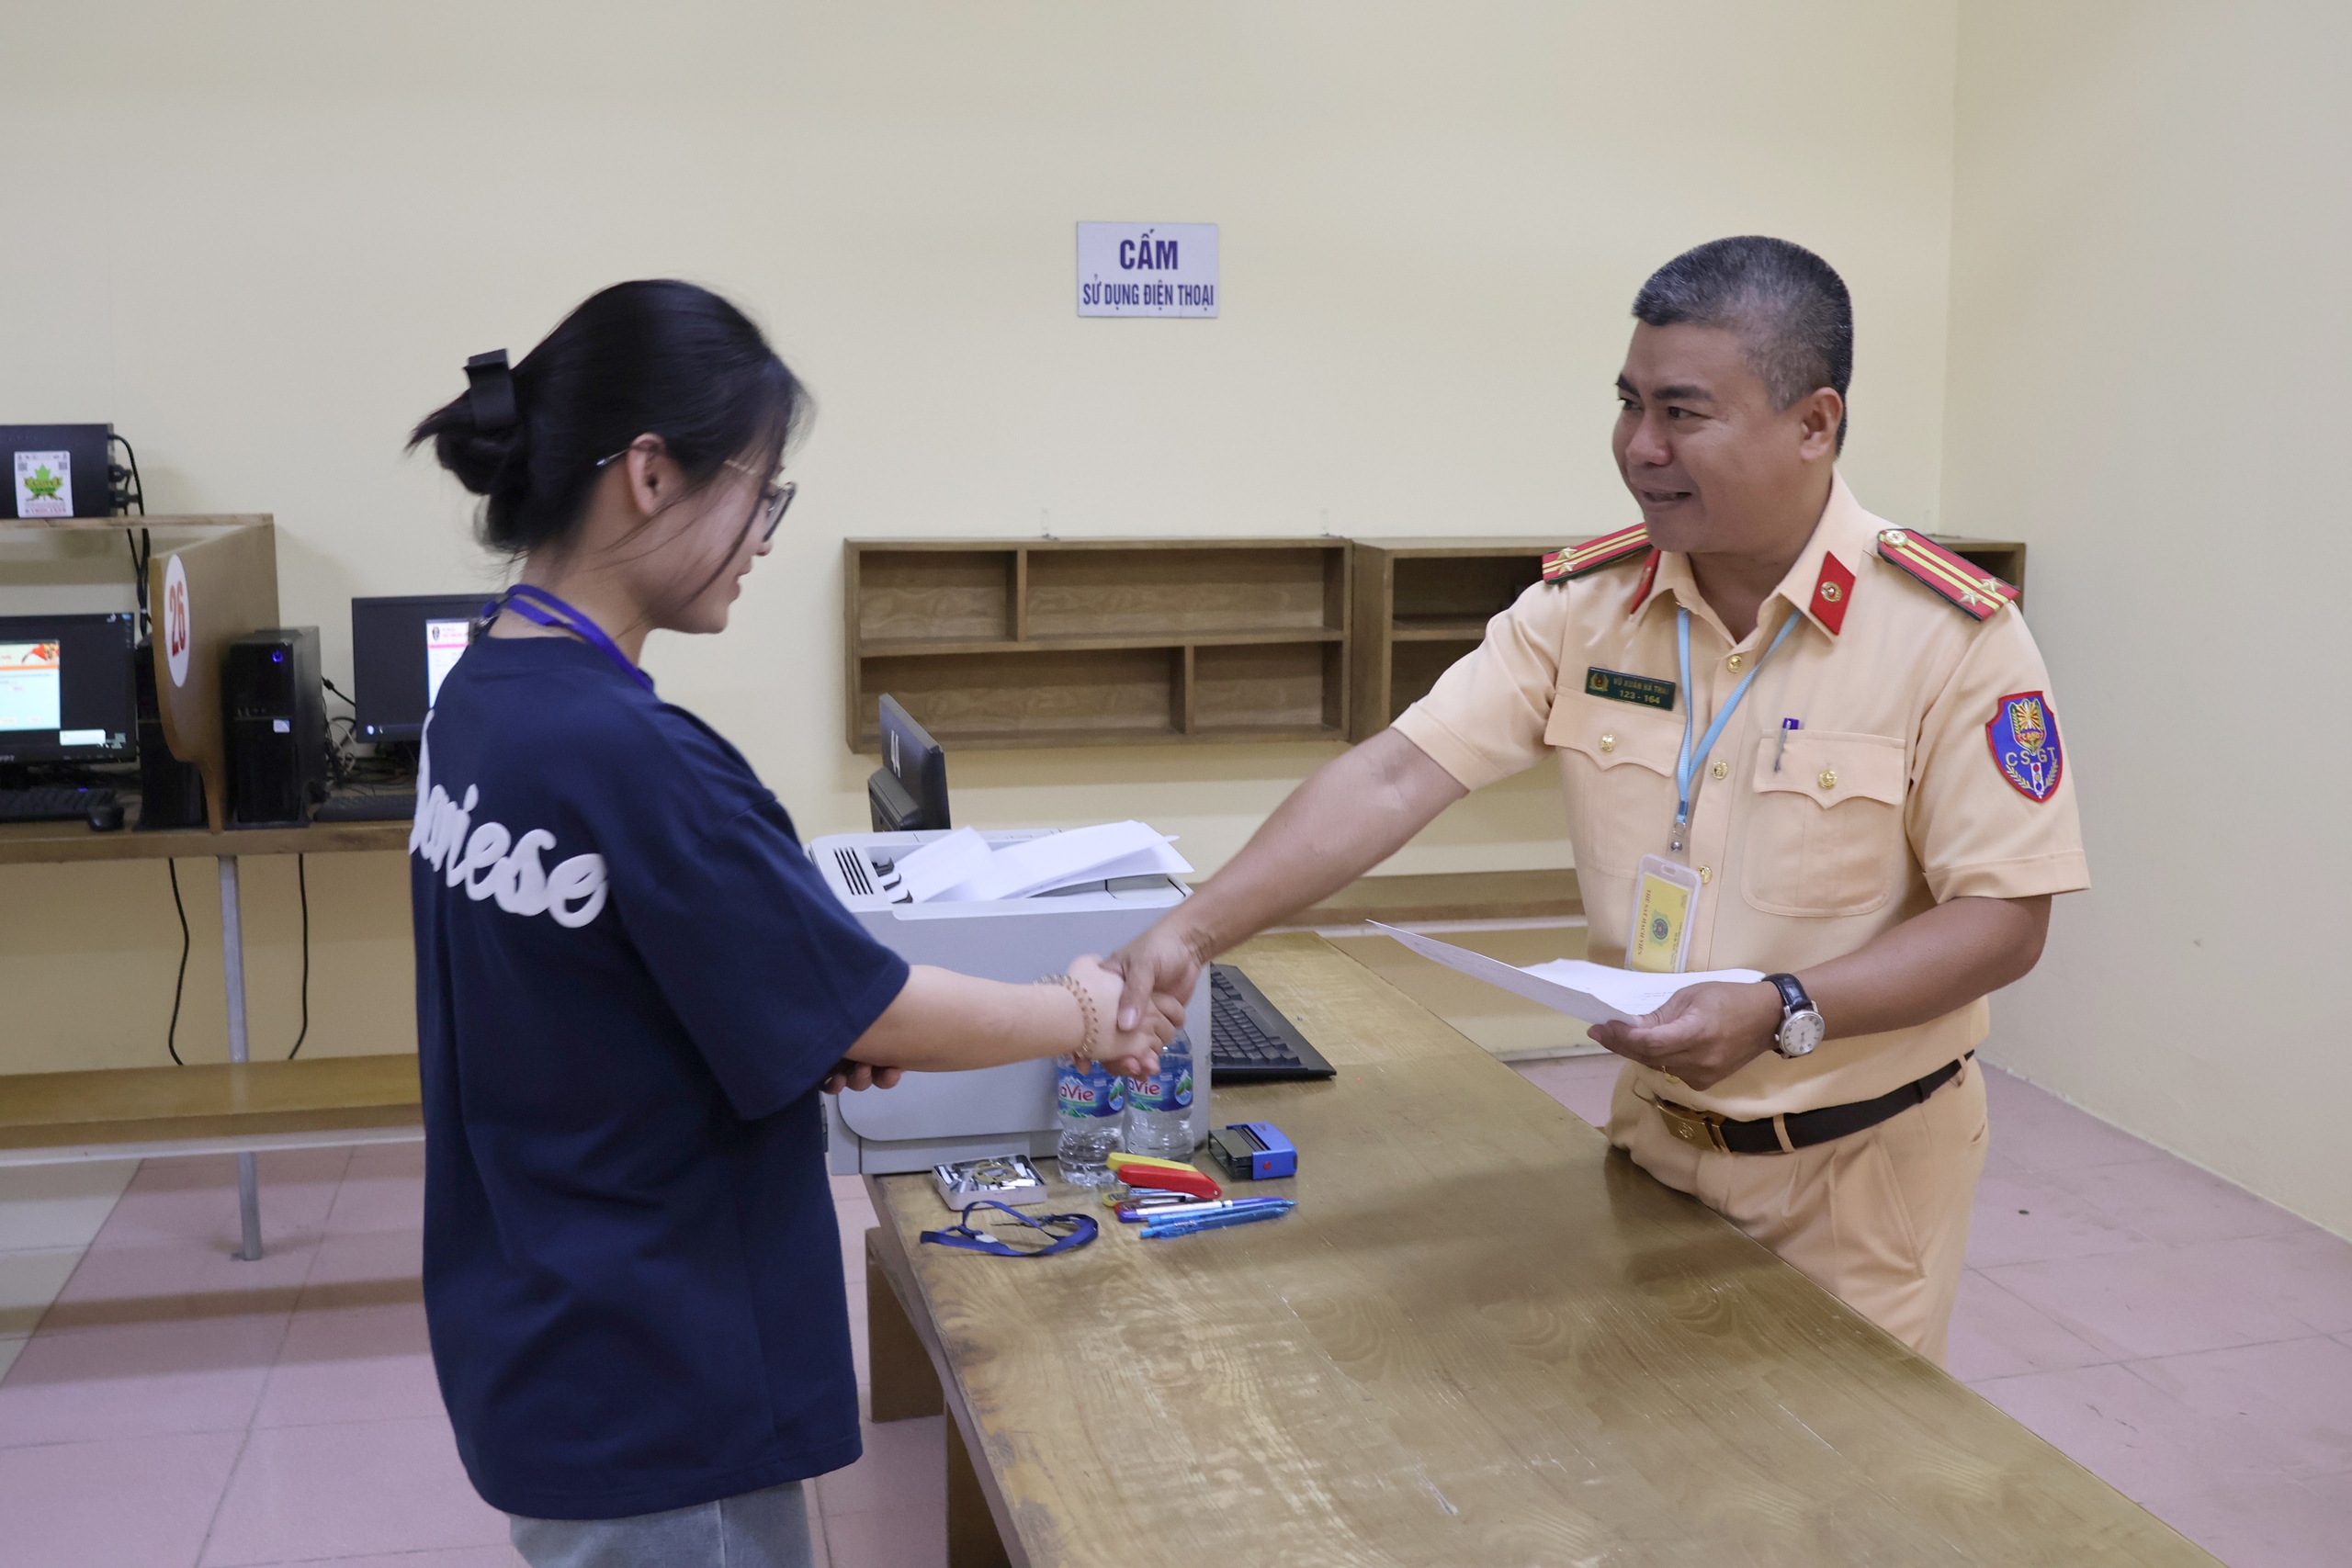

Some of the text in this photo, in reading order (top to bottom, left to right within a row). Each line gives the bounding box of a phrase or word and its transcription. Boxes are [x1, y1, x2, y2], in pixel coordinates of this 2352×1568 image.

[1120, 229, 1179, 270] CẤM
[1082, 274, 1215, 311] SỬ DỤNG ĐIỆN THOẠI
[169, 581, 186, 658] 26
[1620, 690, 1635, 699] 123
[1644, 694, 1660, 704] 164
[1059, 1083, 1094, 1101] aVie
[1128, 1077, 1160, 1096] aVie
